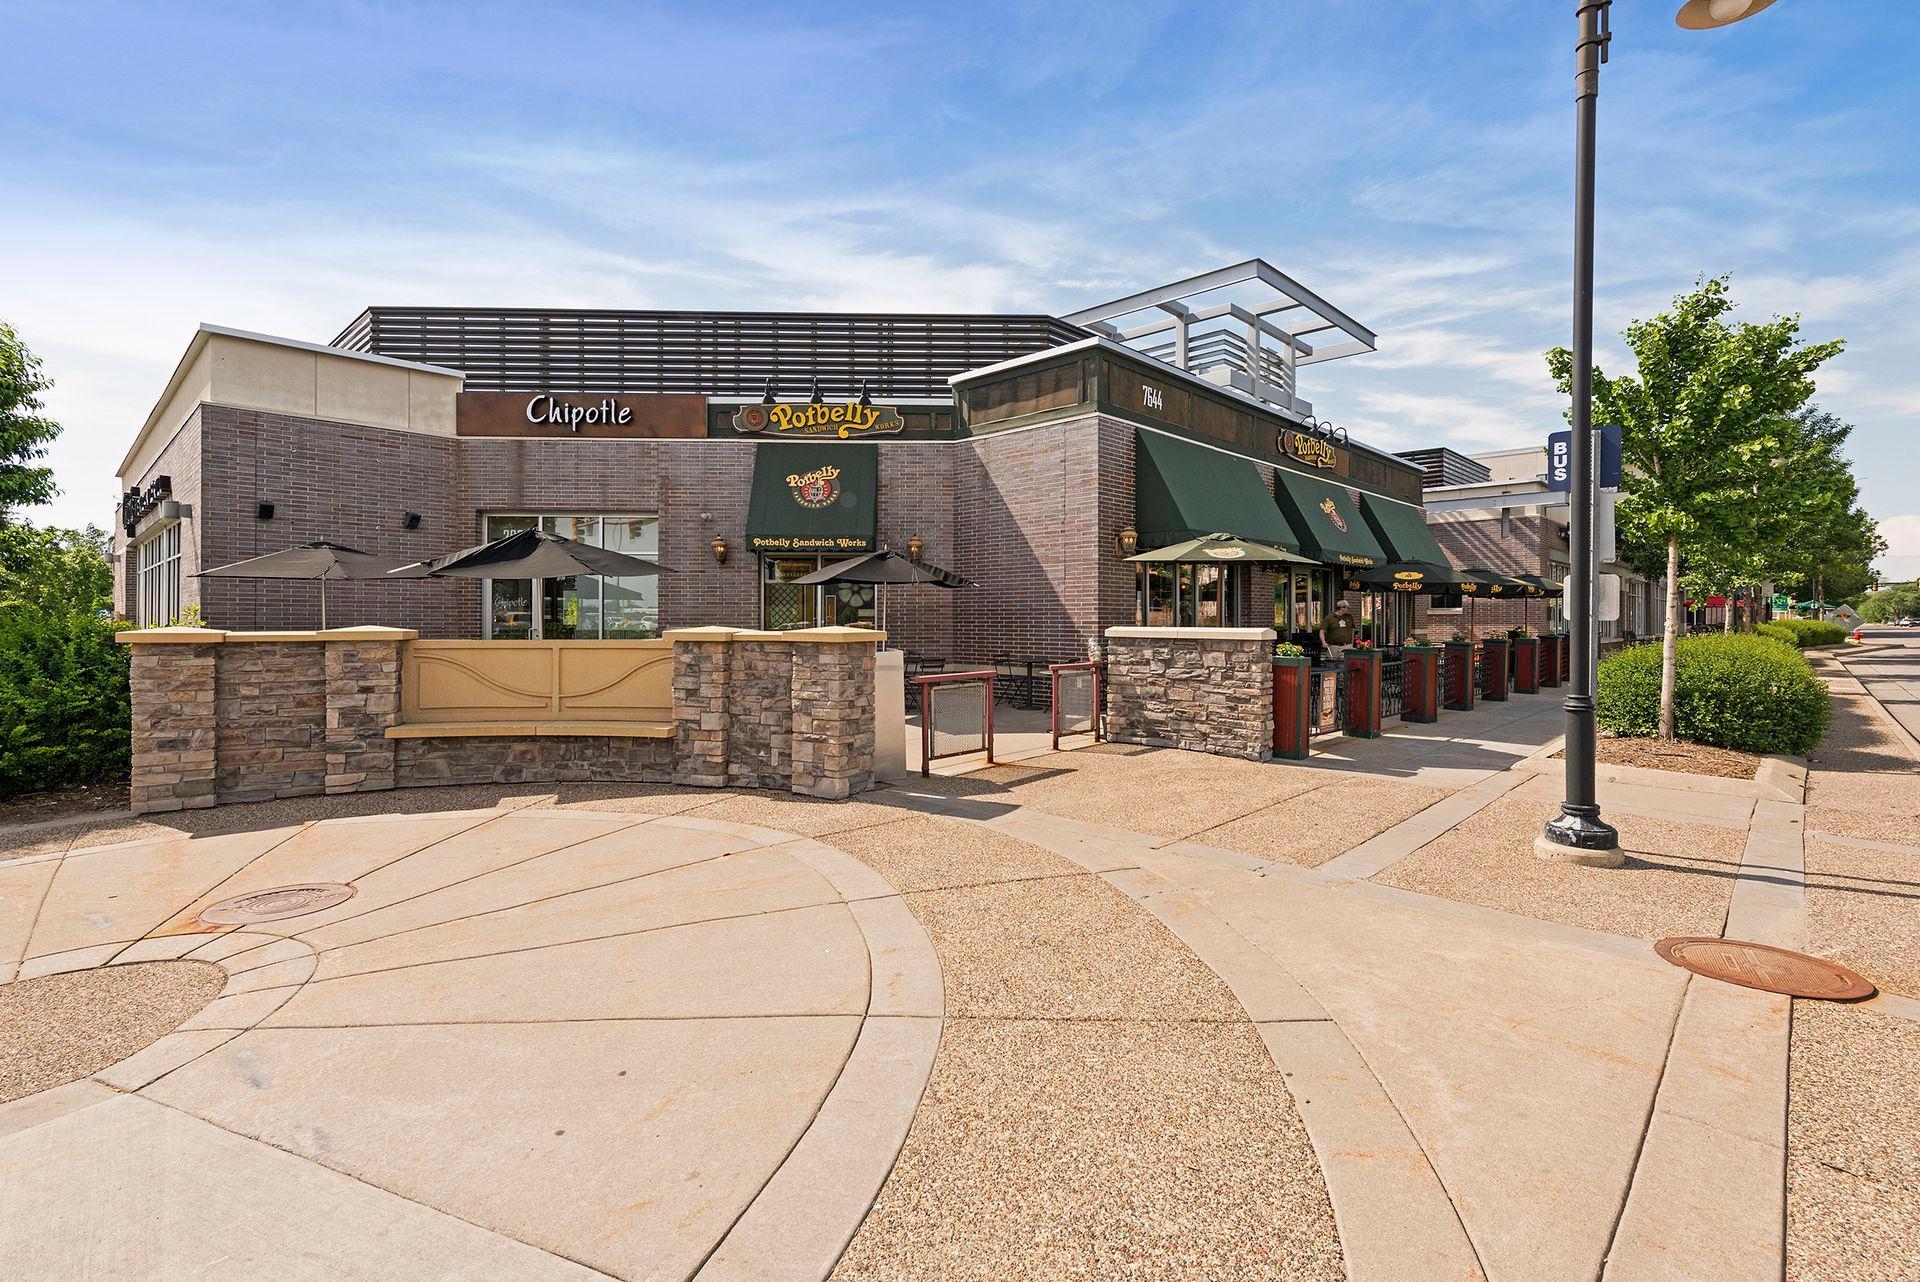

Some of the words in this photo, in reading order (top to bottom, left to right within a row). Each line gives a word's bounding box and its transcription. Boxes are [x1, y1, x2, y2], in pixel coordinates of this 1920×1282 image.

[1142, 385, 1163, 410] 7644
[526, 395, 632, 431] Chipotle
[770, 402, 880, 439] Potbelly
[804, 424, 839, 435] SANDWICH
[874, 420, 900, 431] WORKS
[1295, 433, 1331, 468] Potbelly
[1553, 441, 1568, 481] BUS
[786, 465, 840, 486] Potbelly
[753, 537, 790, 548] Potbelly
[793, 538, 835, 548] Sandwich
[837, 538, 867, 547] Works
